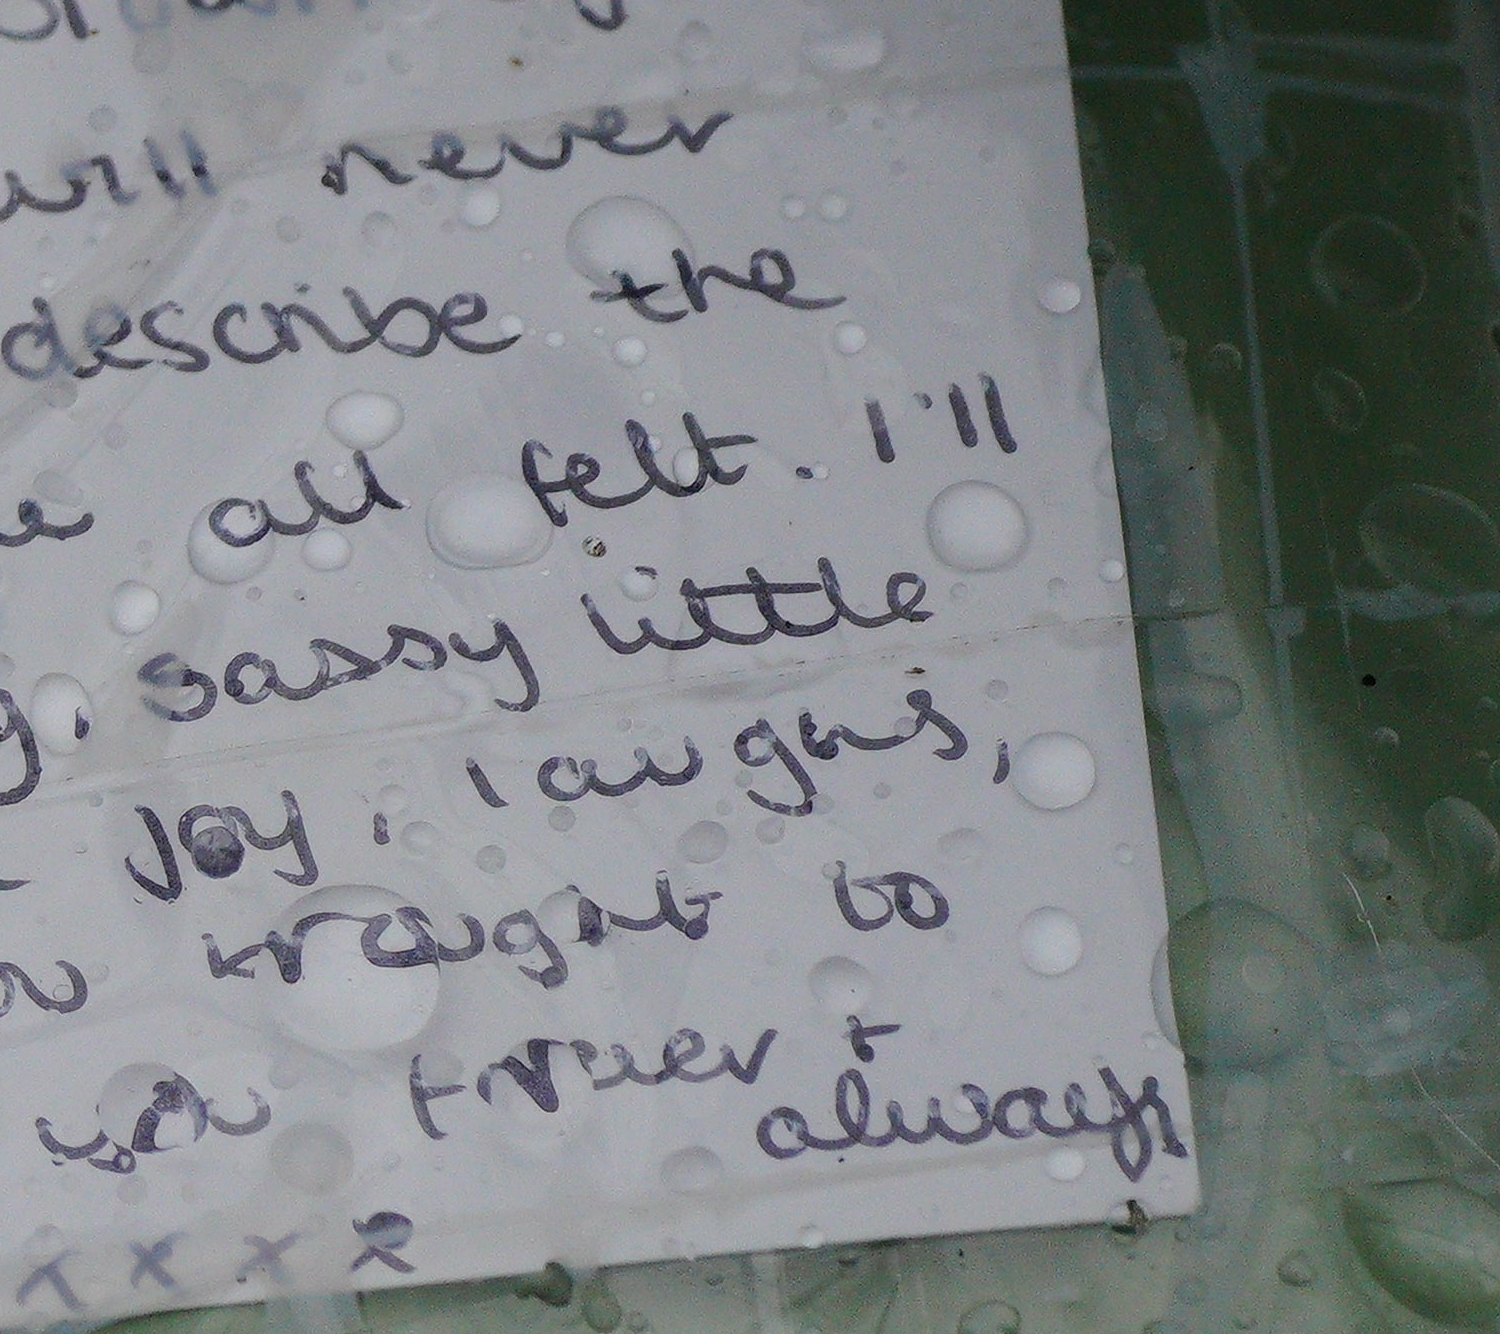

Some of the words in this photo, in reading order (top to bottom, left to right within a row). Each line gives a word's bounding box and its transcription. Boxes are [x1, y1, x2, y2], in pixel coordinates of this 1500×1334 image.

[322, 104, 733, 195] never
[0, 280, 523, 382] describe
[591, 245, 846, 327] the
[207, 450, 404, 548] all
[579, 555, 935, 656] little
[831, 860, 952, 933] to
[755, 1057, 1190, 1184] always
